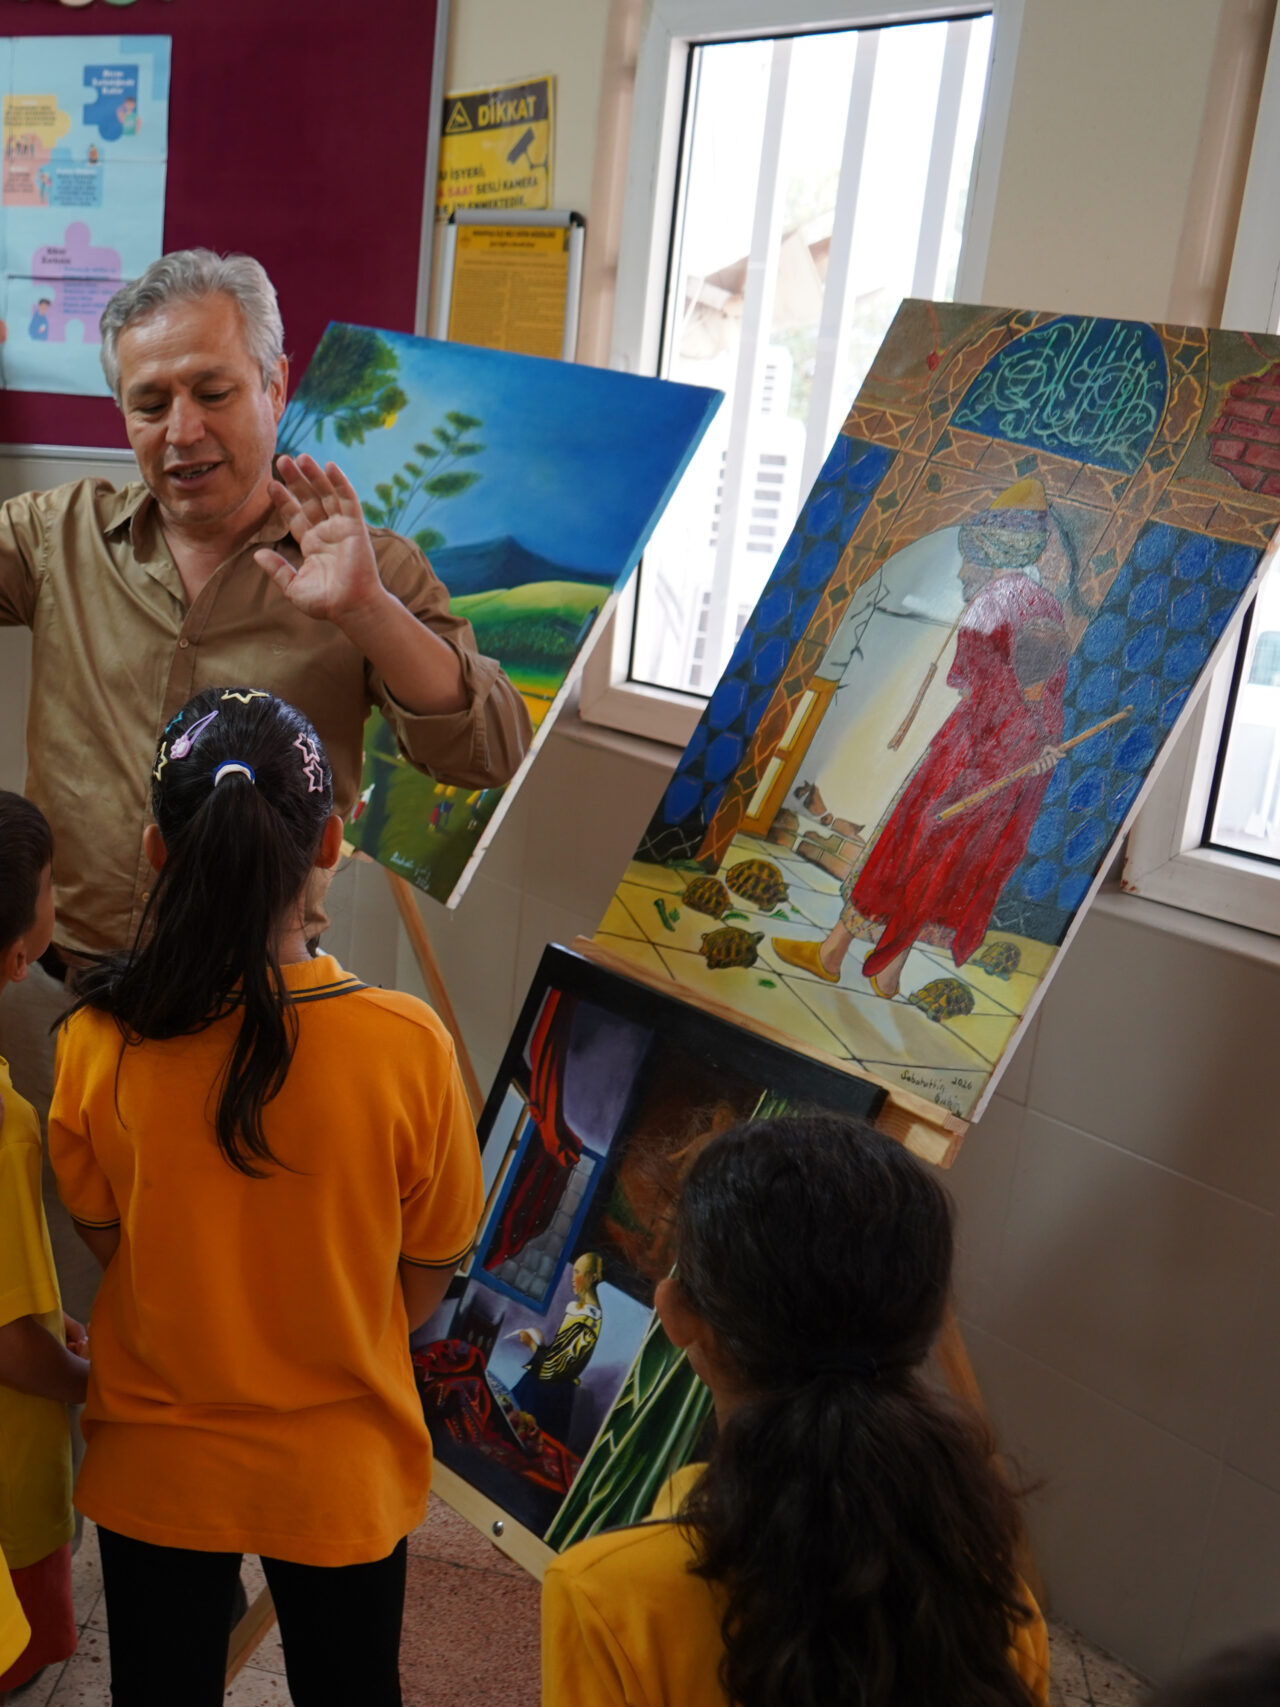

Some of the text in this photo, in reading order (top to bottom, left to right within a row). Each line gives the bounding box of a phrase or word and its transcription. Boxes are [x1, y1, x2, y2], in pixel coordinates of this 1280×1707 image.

[478, 96, 536, 127] DİKKAT
[448, 183, 474, 198] SAAT
[476, 179, 501, 195] SESLİ
[503, 176, 538, 191] KAMERA
